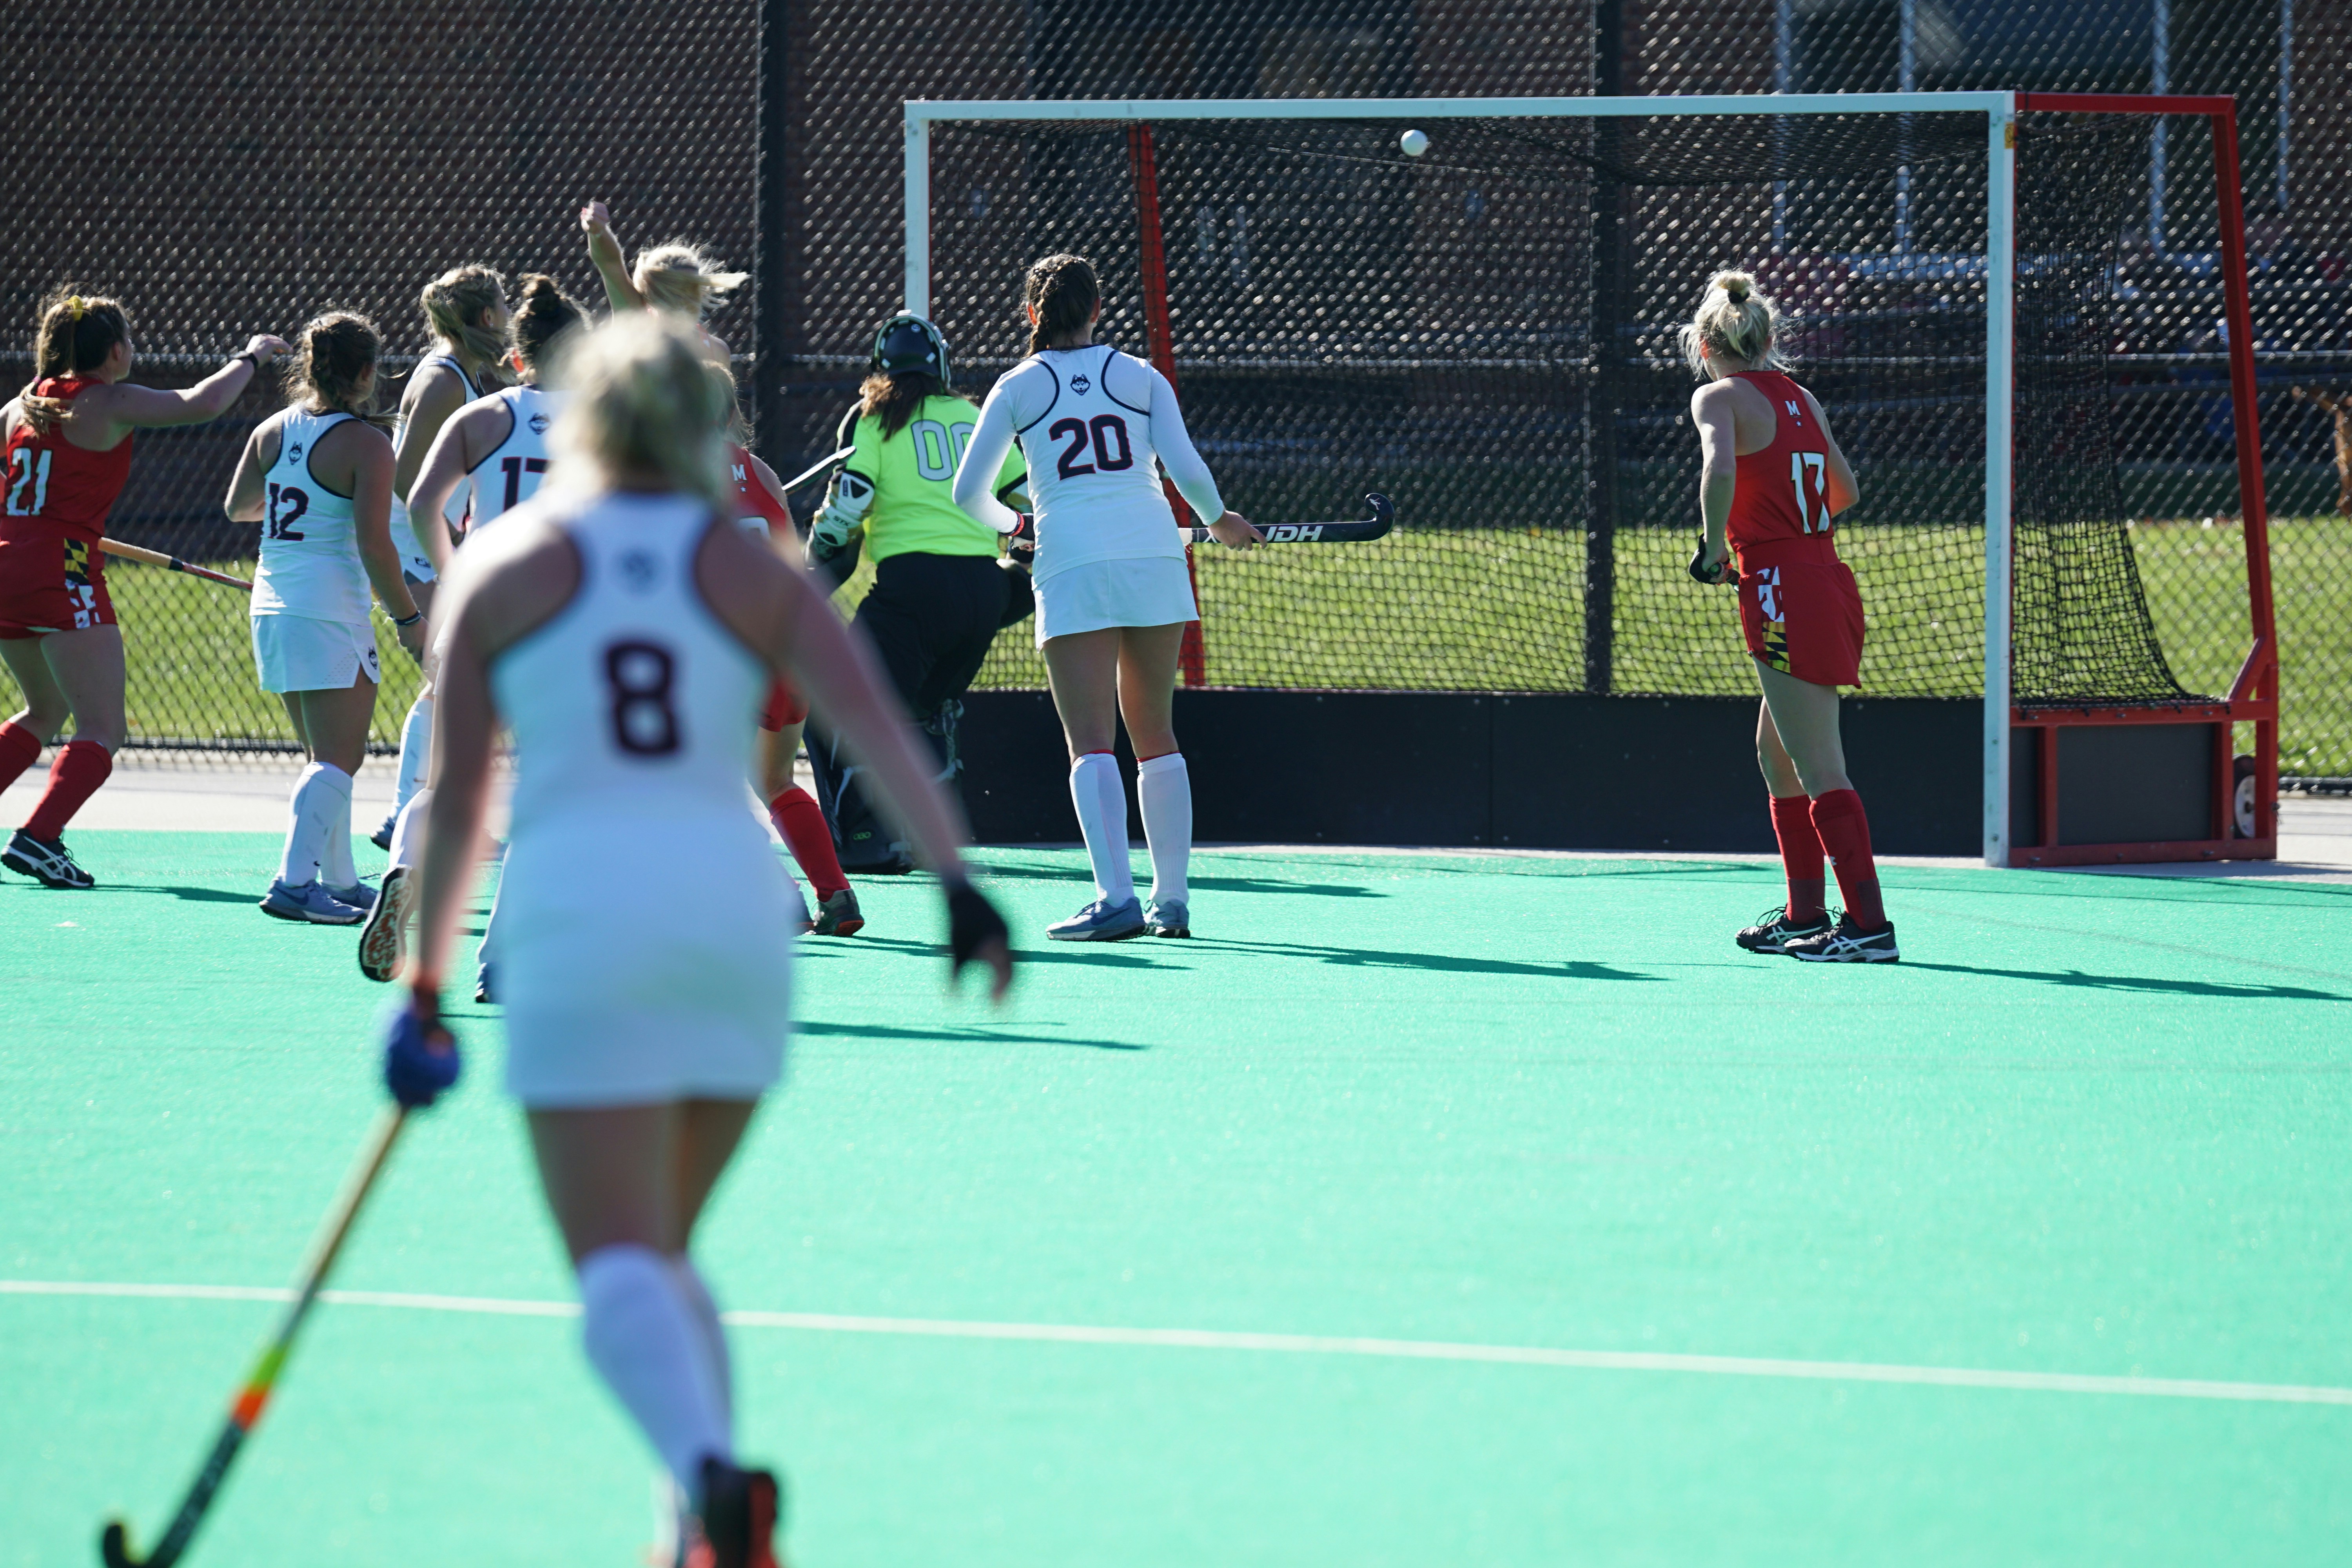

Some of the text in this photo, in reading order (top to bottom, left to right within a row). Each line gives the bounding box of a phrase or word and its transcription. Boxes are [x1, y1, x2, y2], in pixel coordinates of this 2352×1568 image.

[1785, 401, 1801, 416] M
[731, 464, 747, 481] M
[1049, 414, 1133, 481] 20
[6, 447, 53, 516] 21
[1791, 452, 1829, 535] 17
[268, 483, 309, 541] 12
[833, 515, 851, 526] STX
[1258, 525, 1324, 542] JDH
[604, 642, 681, 757] 8
